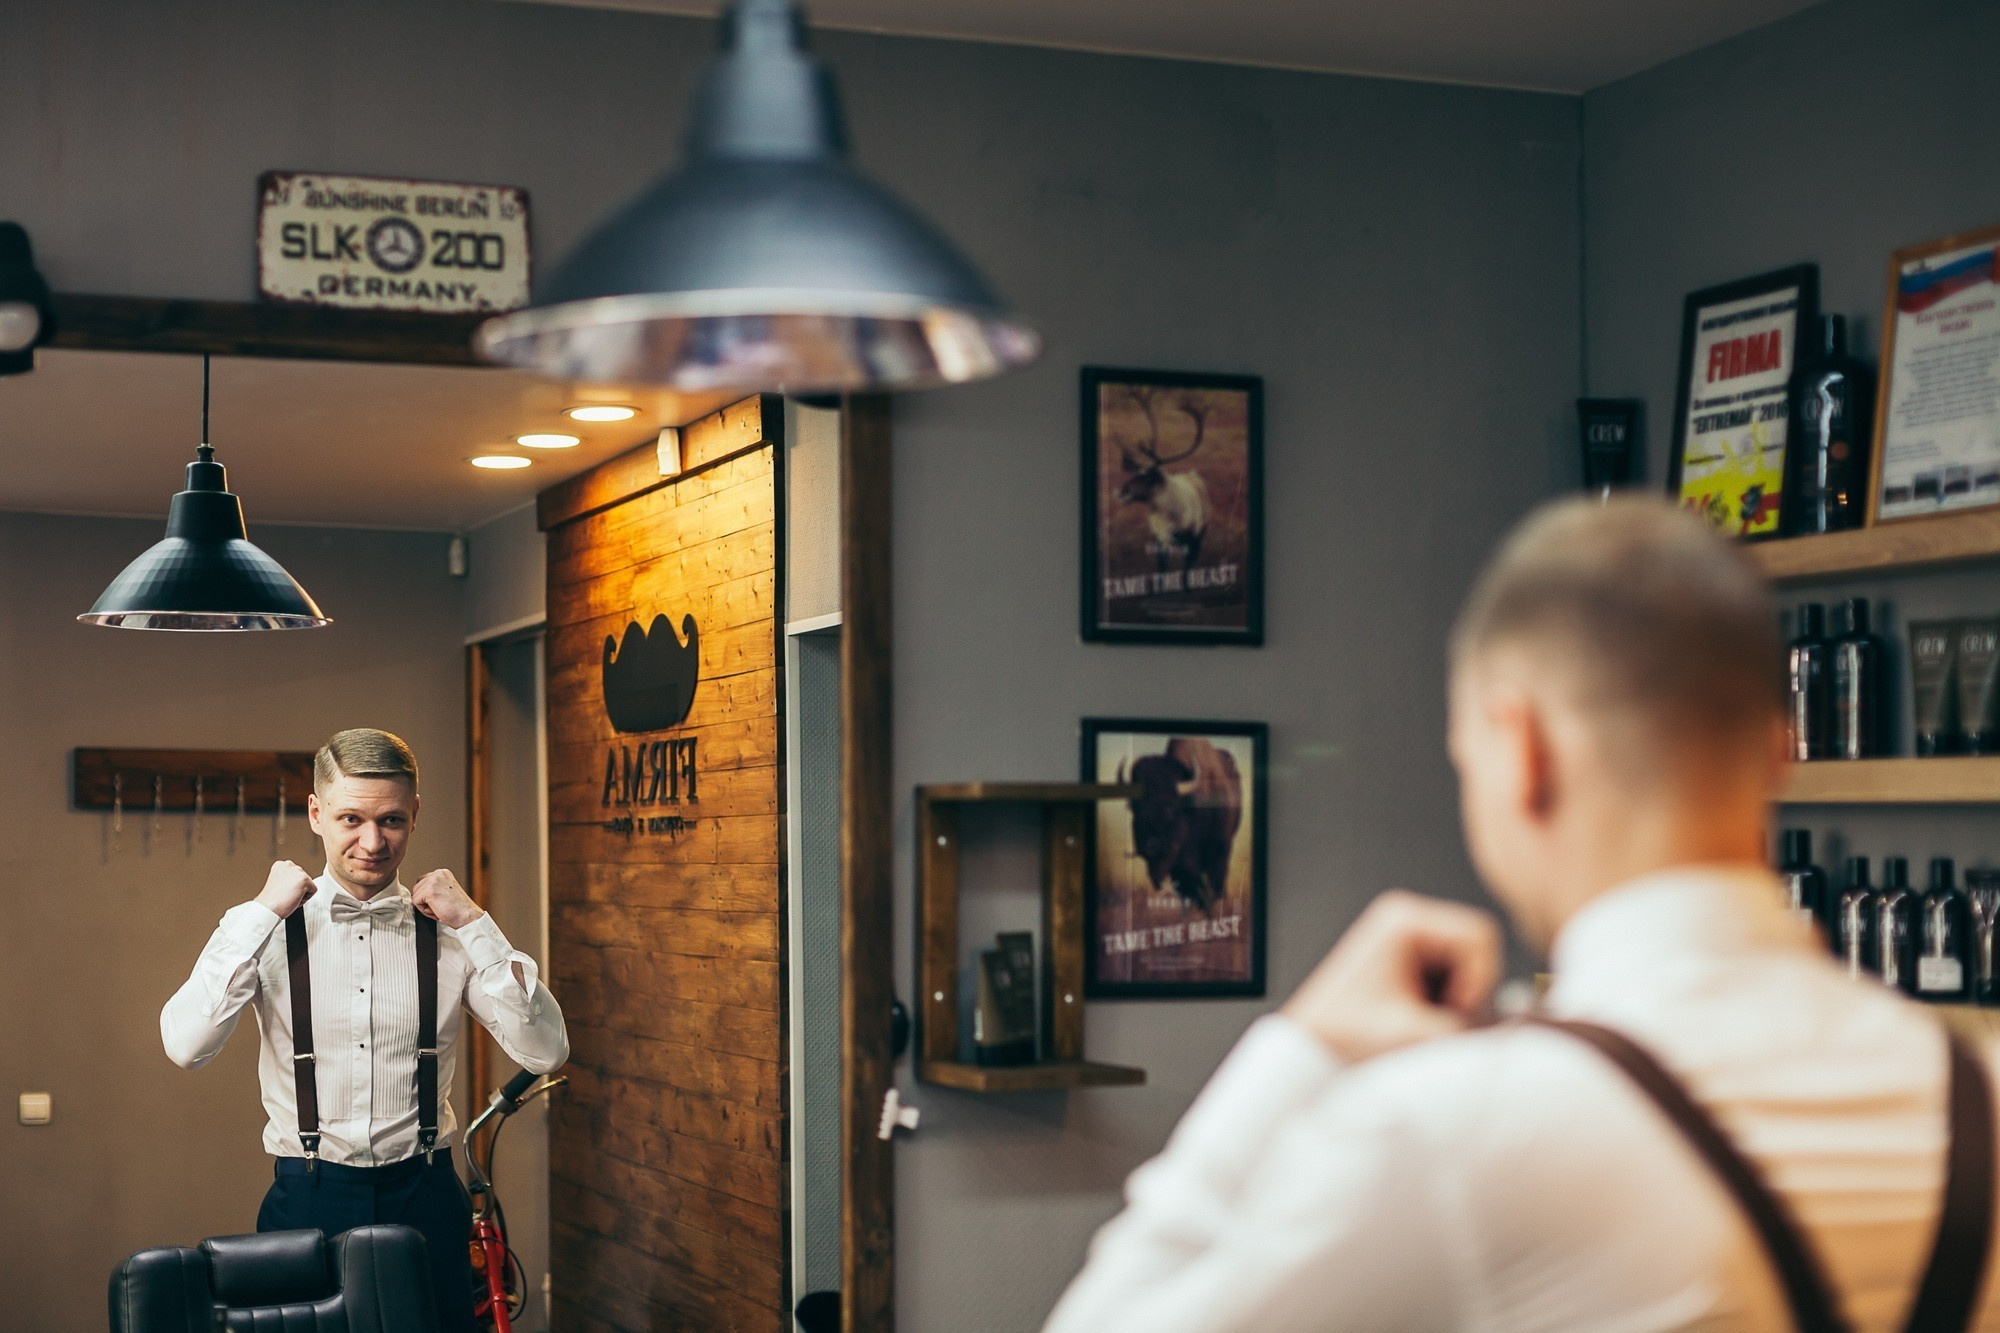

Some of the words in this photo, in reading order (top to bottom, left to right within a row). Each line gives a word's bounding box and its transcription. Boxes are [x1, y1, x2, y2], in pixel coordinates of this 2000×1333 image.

[305, 189, 407, 214] SUNSHINE
[415, 195, 490, 219] BERLIN
[281, 222, 361, 262] SLK
[431, 229, 504, 271] 200
[318, 274, 478, 301] GERMANY
[1707, 329, 1782, 384] FIRMA
[1588, 424, 1626, 443] CREW
[1104, 574, 1147, 599] TAME
[1152, 571, 1184, 593] THE
[1187, 563, 1239, 590] BEAST
[1918, 636, 1948, 656] CREW
[1964, 634, 1998, 656] CREW
[1104, 929, 1149, 956] TAME
[1152, 924, 1185, 948] THE
[1188, 915, 1241, 943] BEAST
